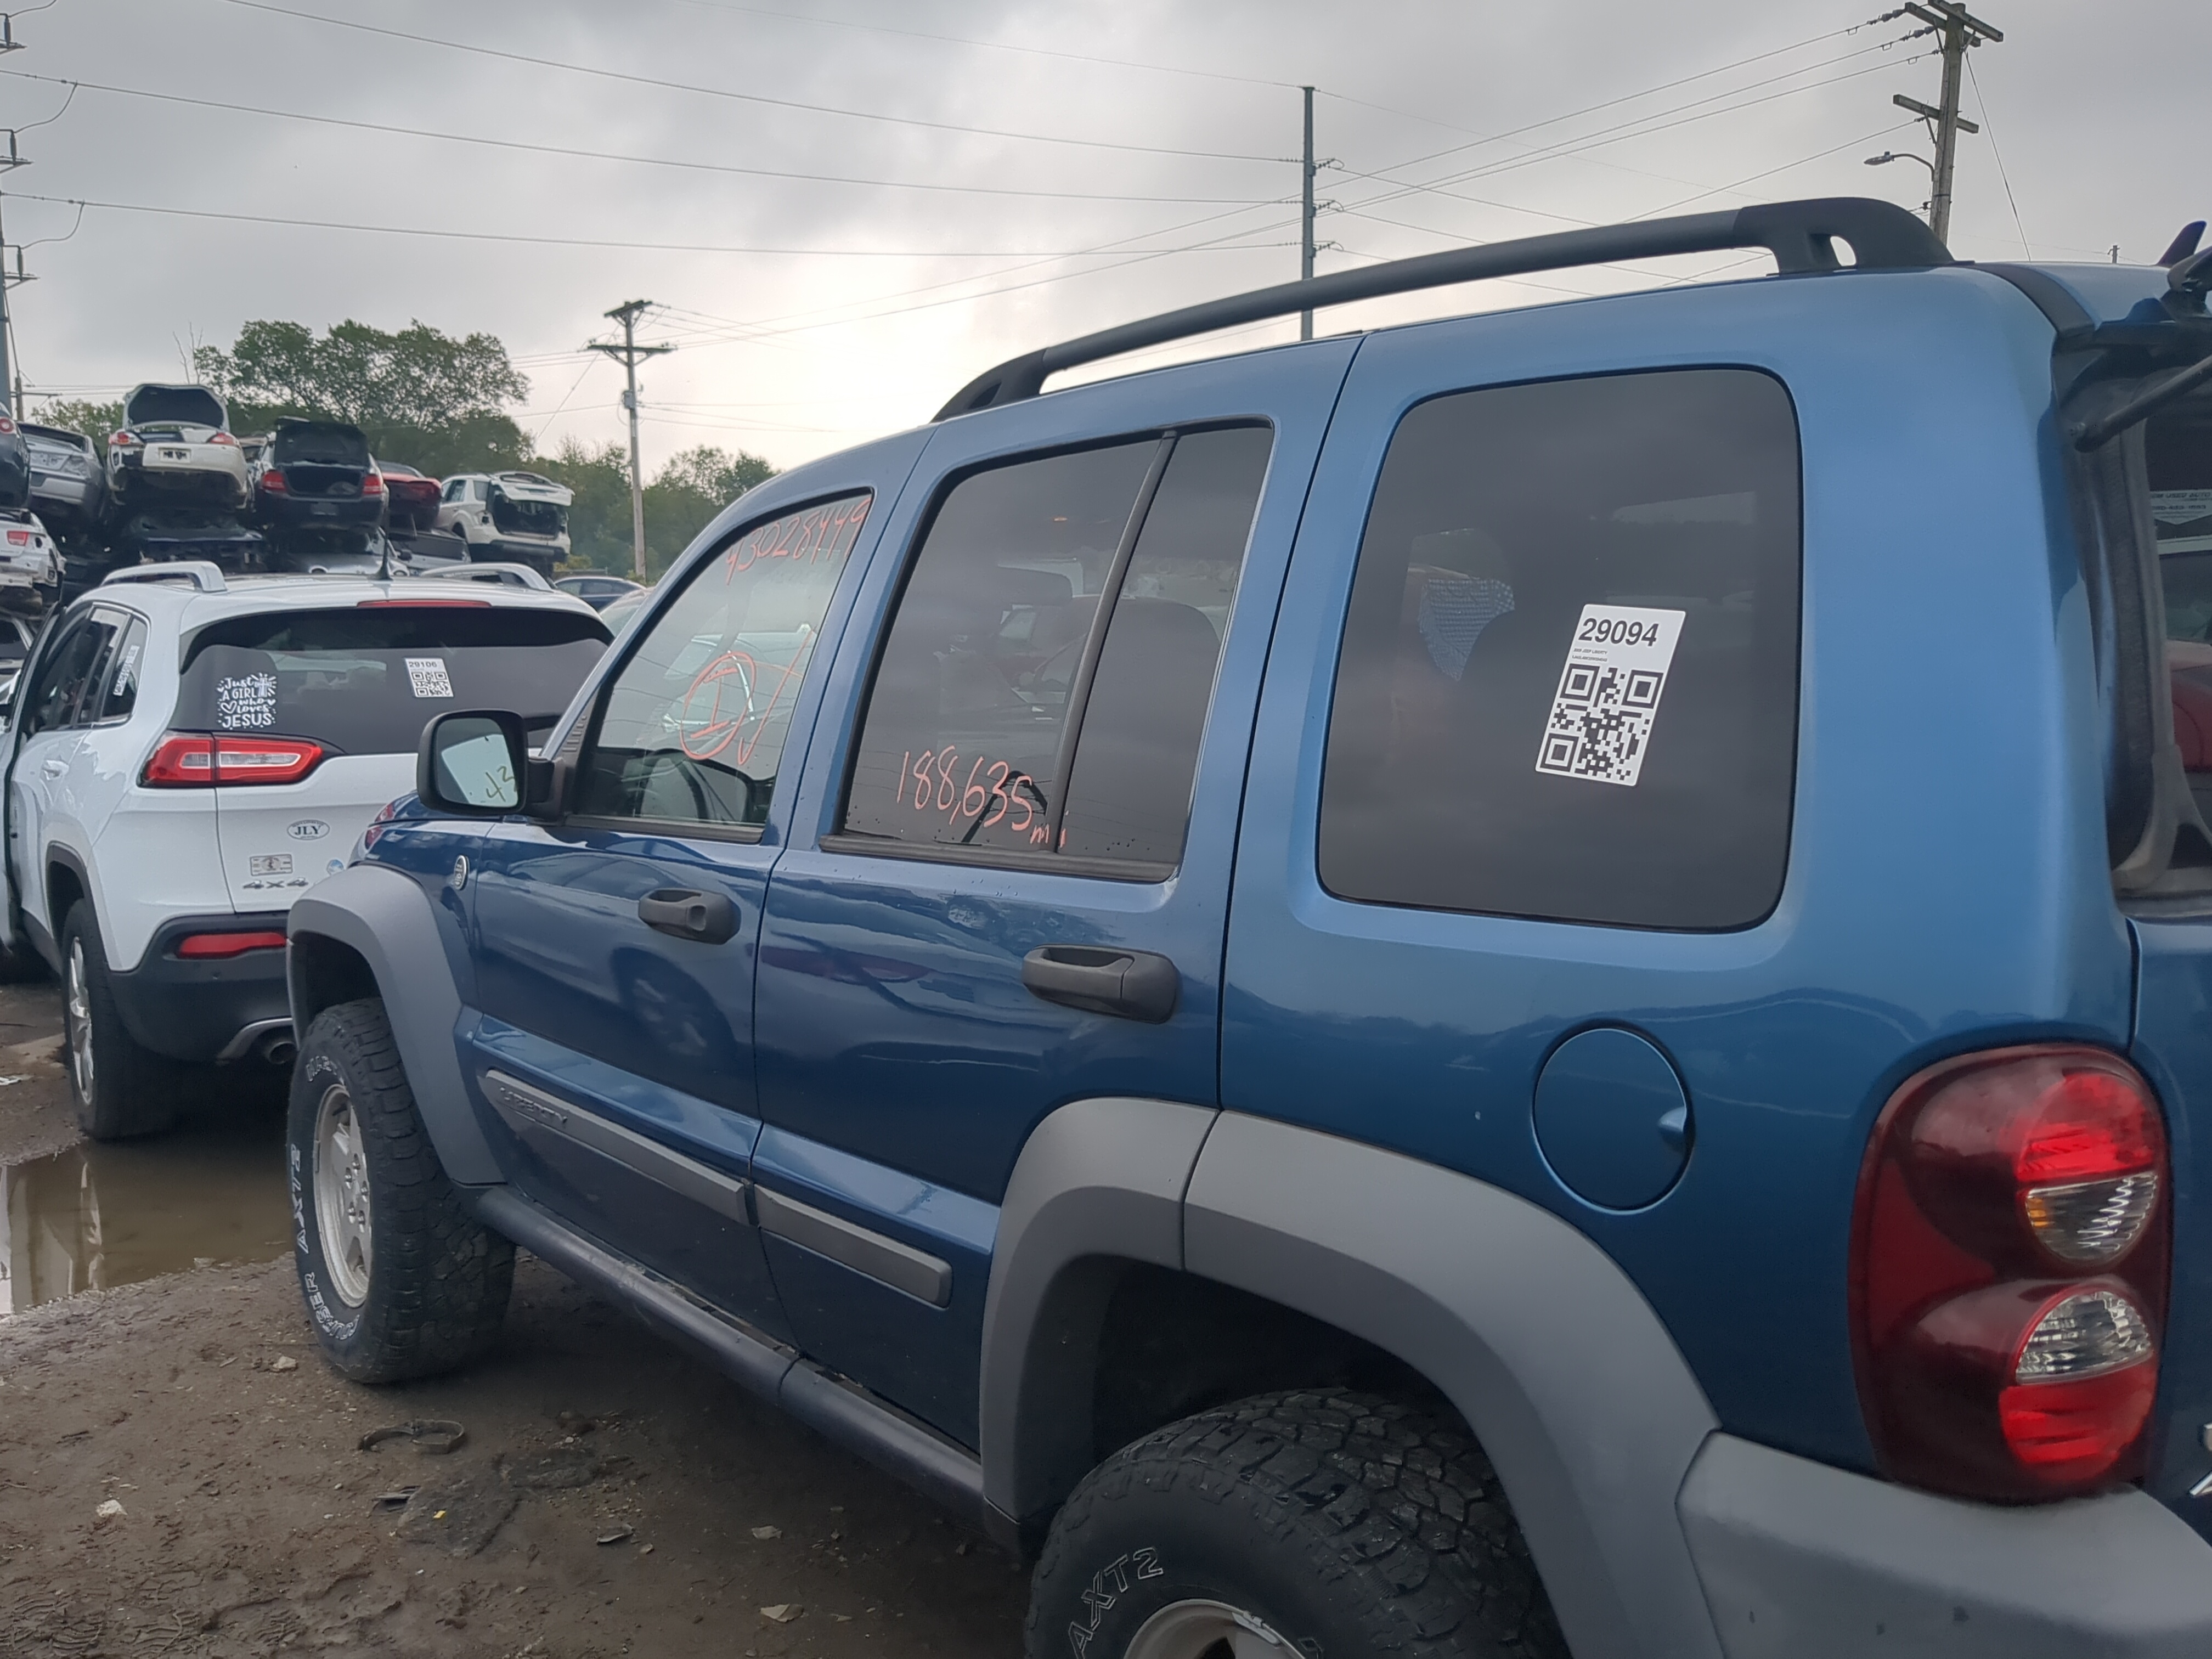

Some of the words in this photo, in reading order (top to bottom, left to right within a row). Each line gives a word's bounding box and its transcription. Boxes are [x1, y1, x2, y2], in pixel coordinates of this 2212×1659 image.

[1578, 618, 1659, 647] 29094
[224, 676, 254, 690] Just
[222, 690, 230, 701] A
[232, 687, 257, 699] GIRL
[237, 704, 269, 714] loves
[222, 713, 272, 728] JESUS
[896, 745, 1032, 831] 188,635
[295, 826, 322, 835] JLY
[1068, 1547, 1164, 1659] AXT2
